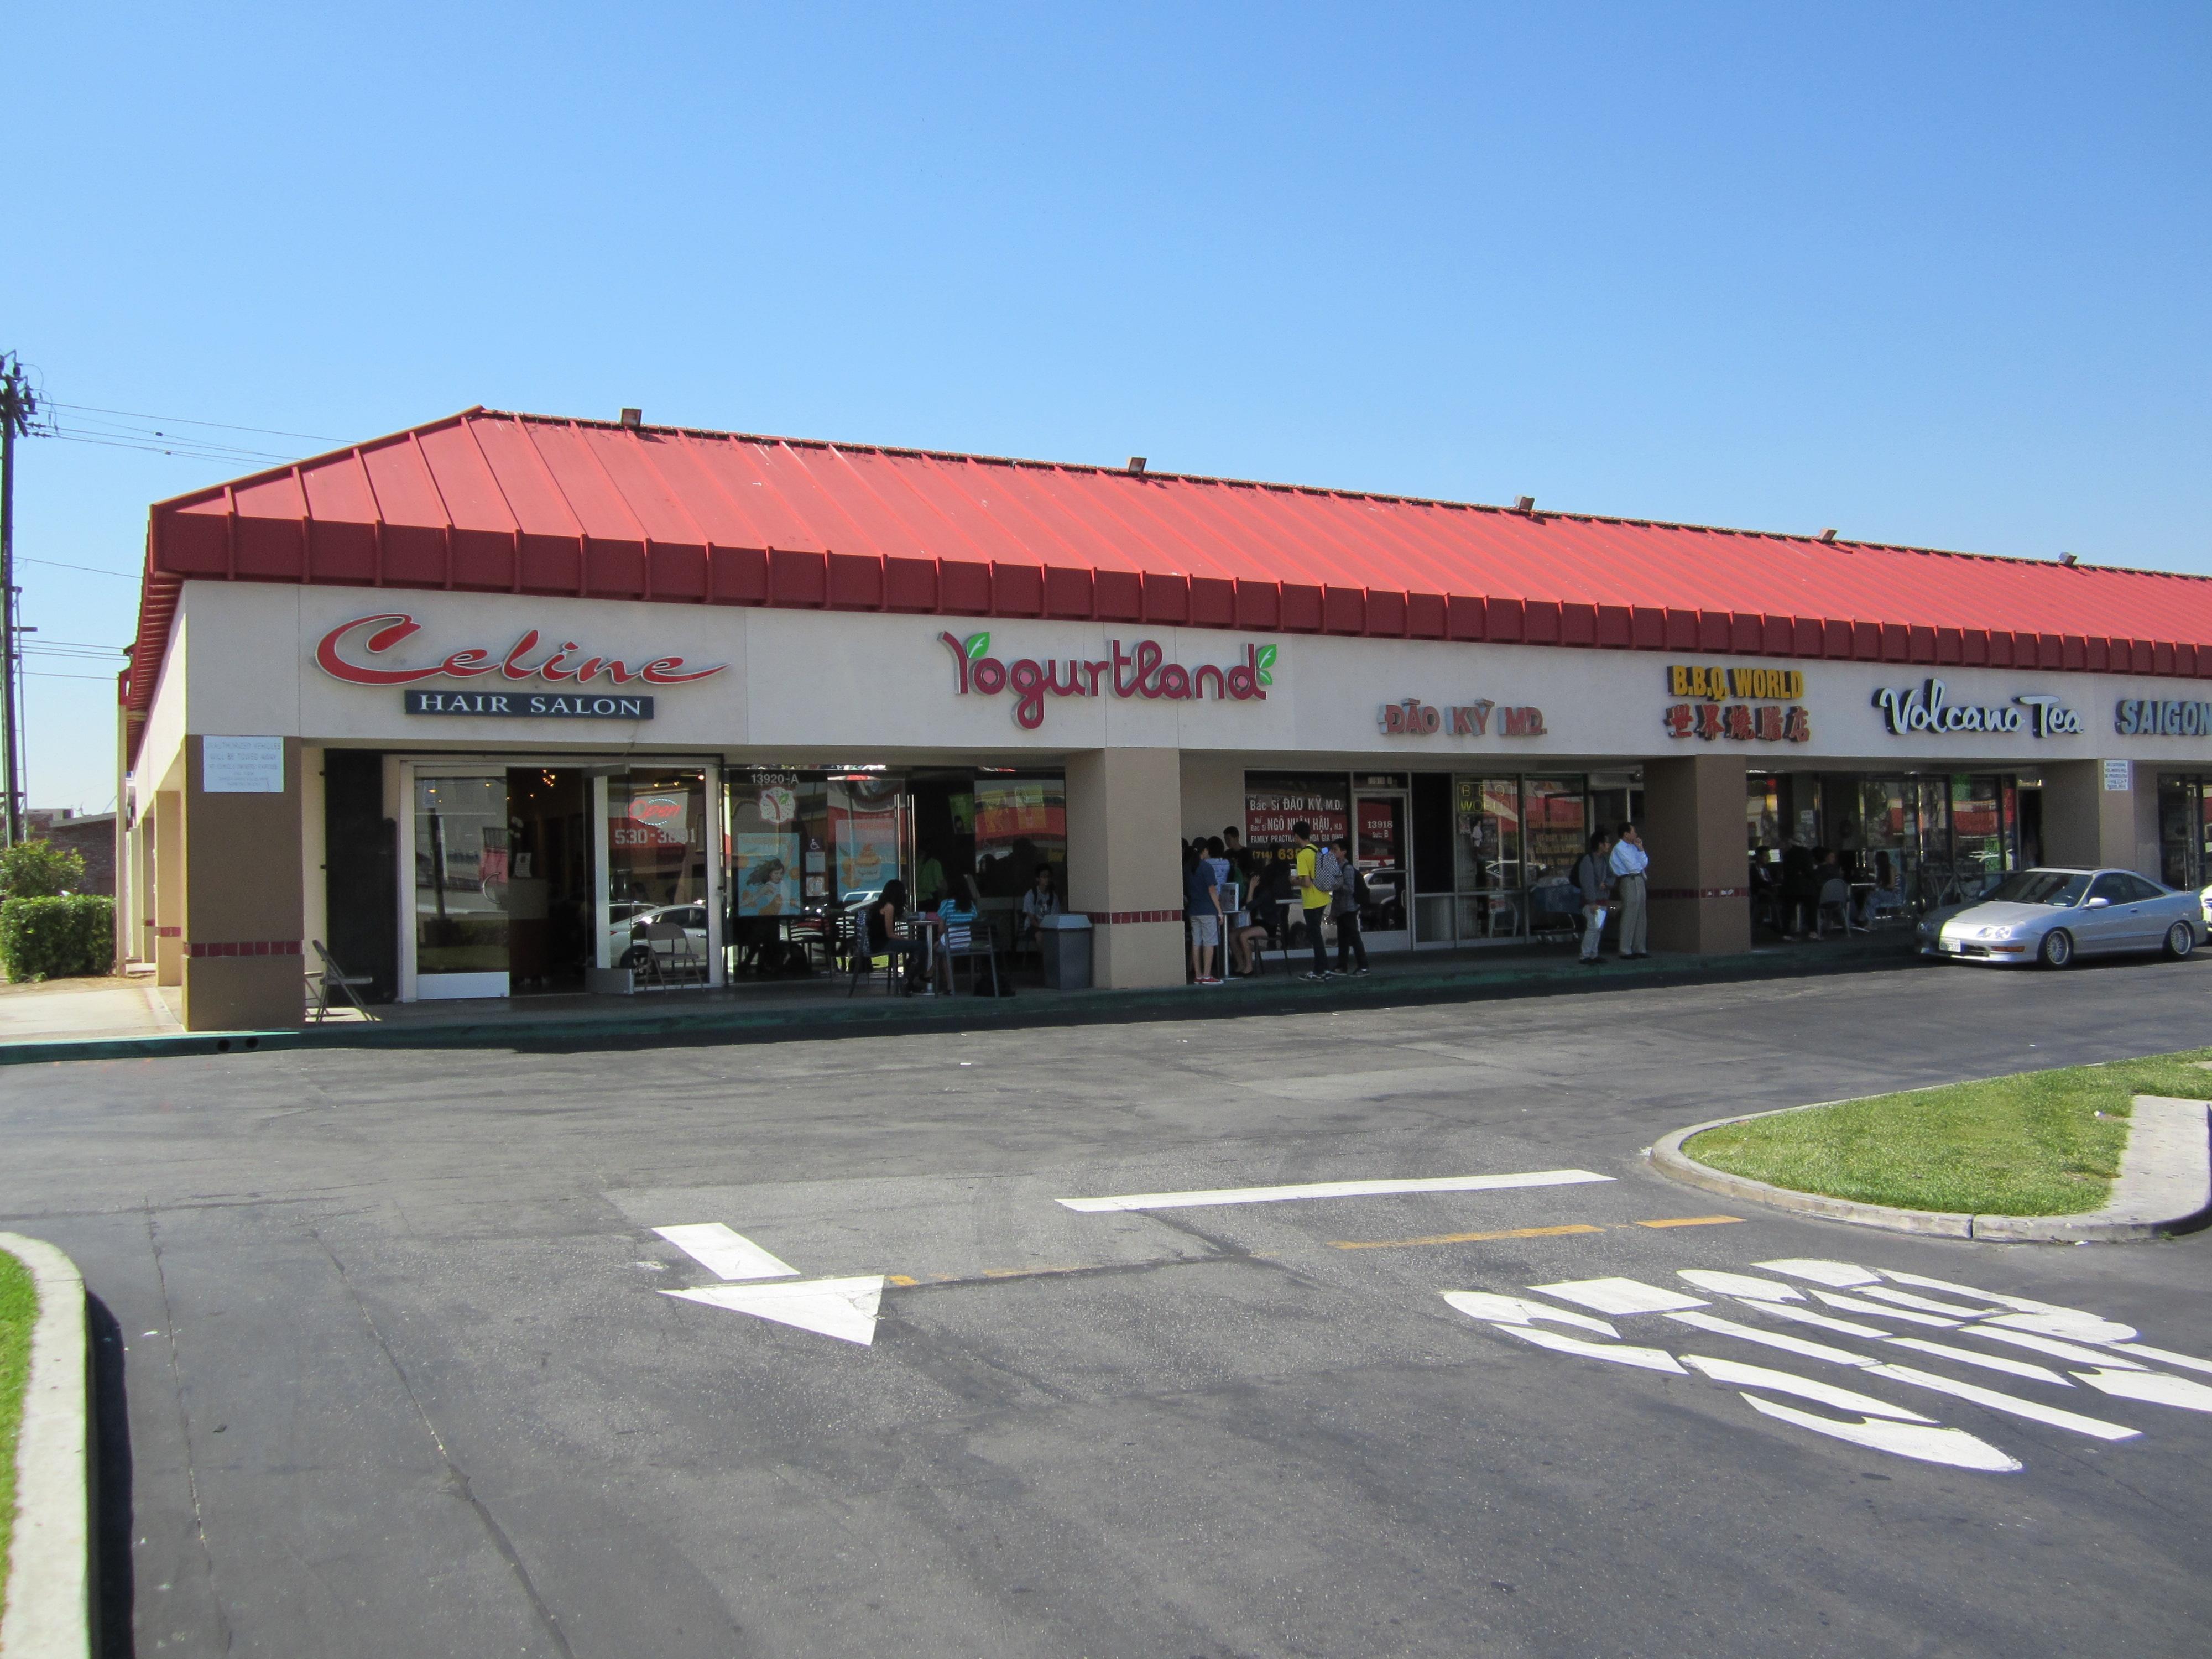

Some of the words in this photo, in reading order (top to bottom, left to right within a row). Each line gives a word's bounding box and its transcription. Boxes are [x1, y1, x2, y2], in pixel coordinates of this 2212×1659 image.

[315, 613, 731, 685] Celine
[937, 631, 1268, 730] Yogurtland
[1731, 667, 1804, 699] WORLD
[418, 693, 512, 713] HAIR
[529, 696, 641, 716] SALON
[1876, 678, 2025, 735] Volcano
[2014, 695, 2084, 739] Tea
[2117, 699, 2212, 735] SAIGON
[750, 773, 799, 784] 13920-A
[628, 799, 682, 820] Open
[1267, 815, 1284, 831] NGÔ
[1367, 820, 1393, 828] 13918
[1250, 835, 1269, 843] FAMILY
[1271, 834, 1295, 843] PRACTIC
